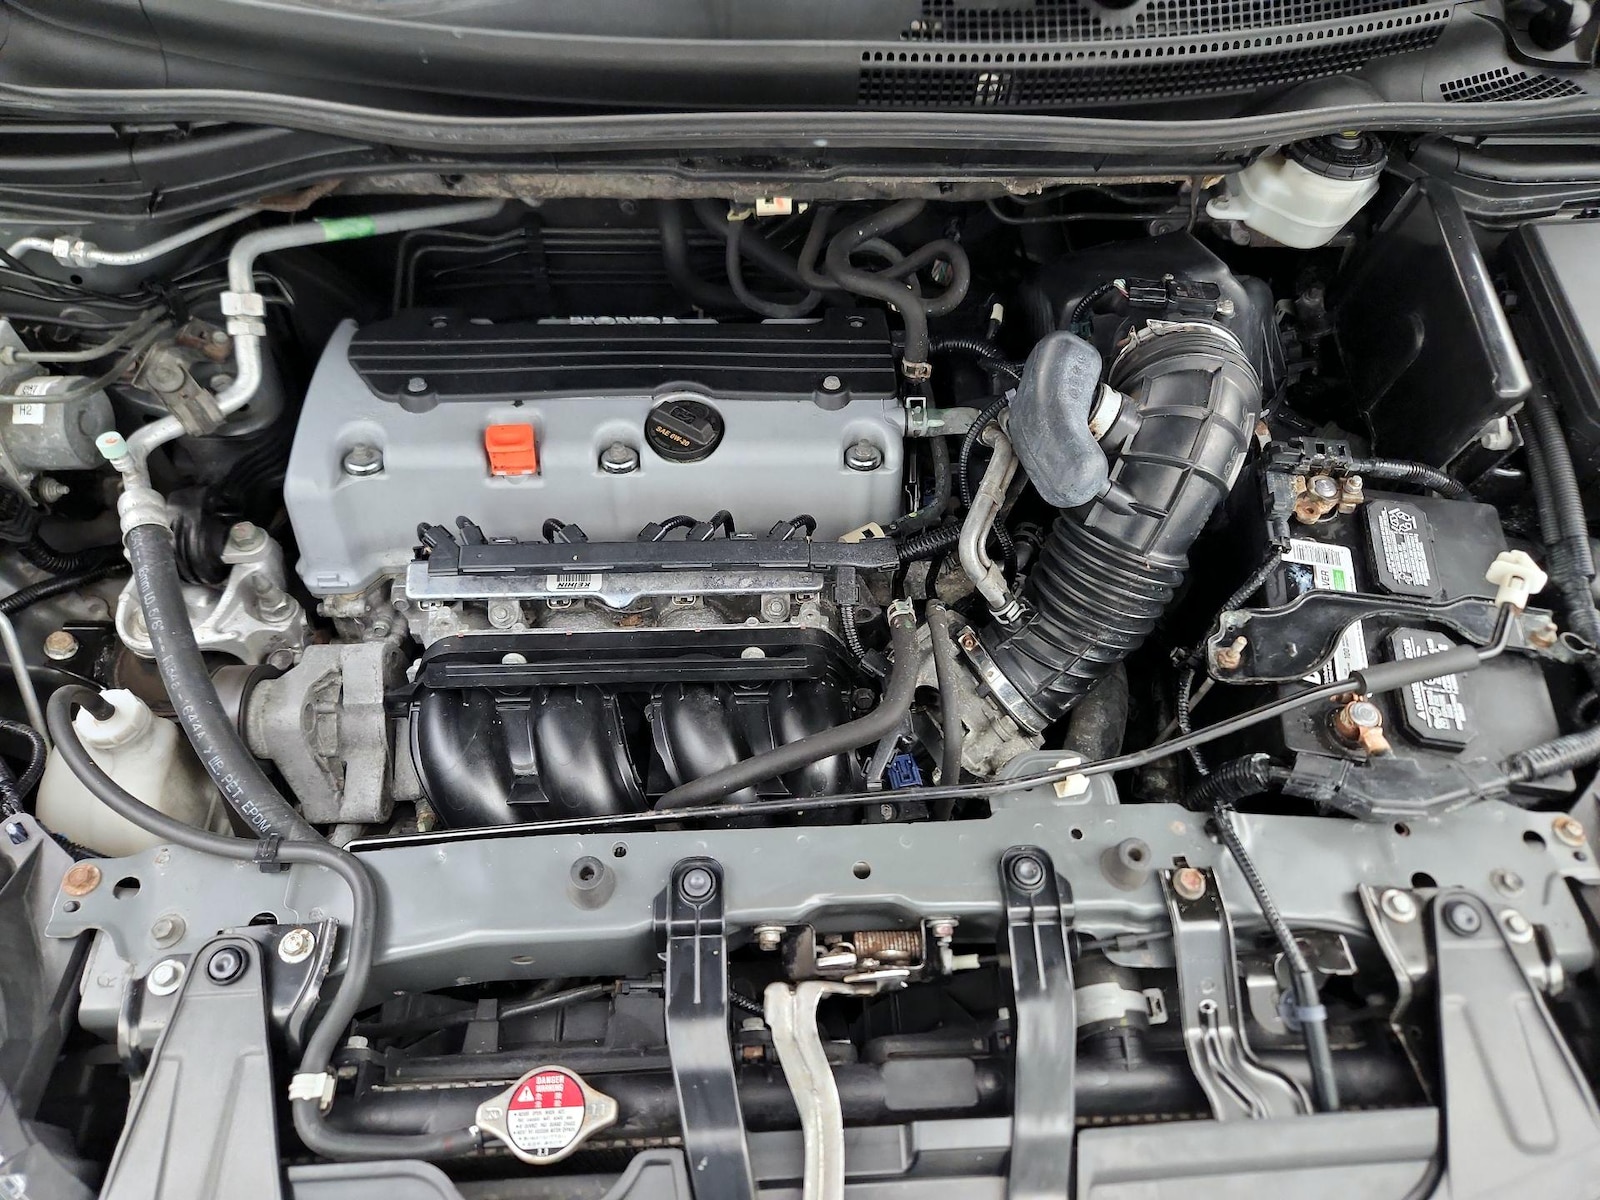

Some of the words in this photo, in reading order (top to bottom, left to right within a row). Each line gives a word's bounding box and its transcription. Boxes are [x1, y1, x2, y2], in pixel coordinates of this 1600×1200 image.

[19, 404, 32, 416] H2
[655, 425, 671, 437] SAE
[669, 433, 691, 447] 0W-20
[536, 1075, 565, 1084] DANGER
